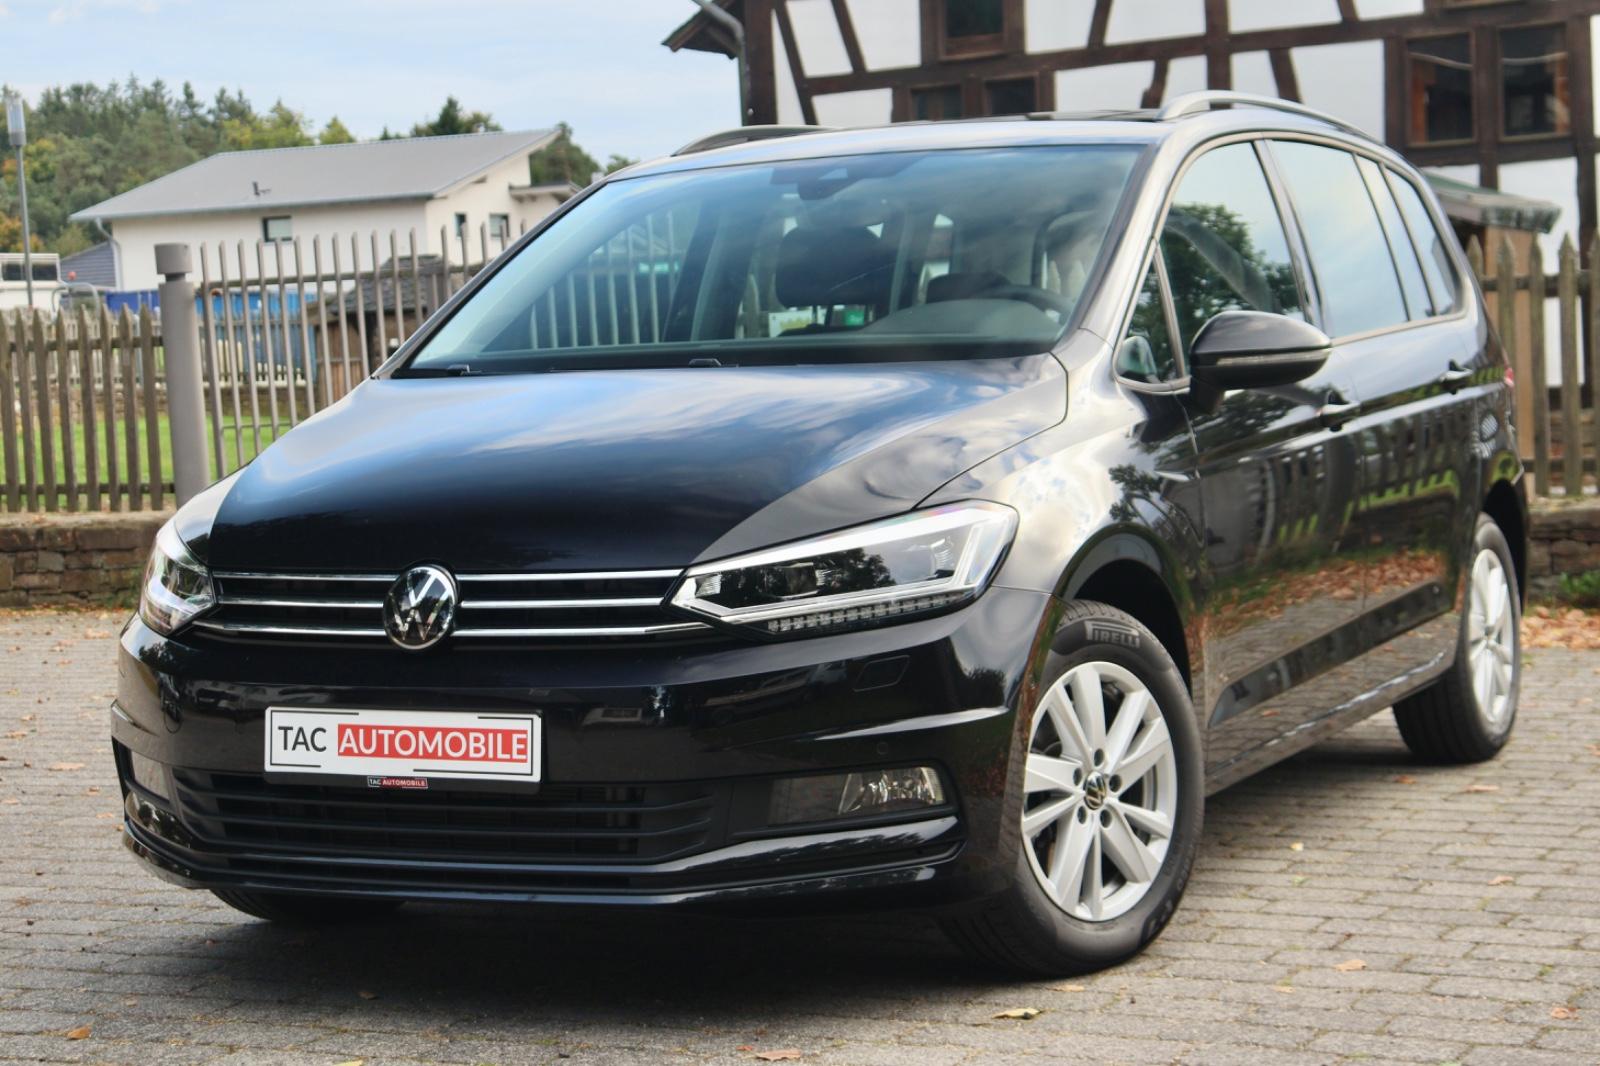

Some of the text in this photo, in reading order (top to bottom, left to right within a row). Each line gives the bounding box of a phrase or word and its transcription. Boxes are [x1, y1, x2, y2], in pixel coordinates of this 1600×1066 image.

[1084, 620, 1140, 648] PIRELLI
[277, 725, 528, 760] TAC AUTOMOBILE
[382, 779, 426, 787] AUTOMOBILE
